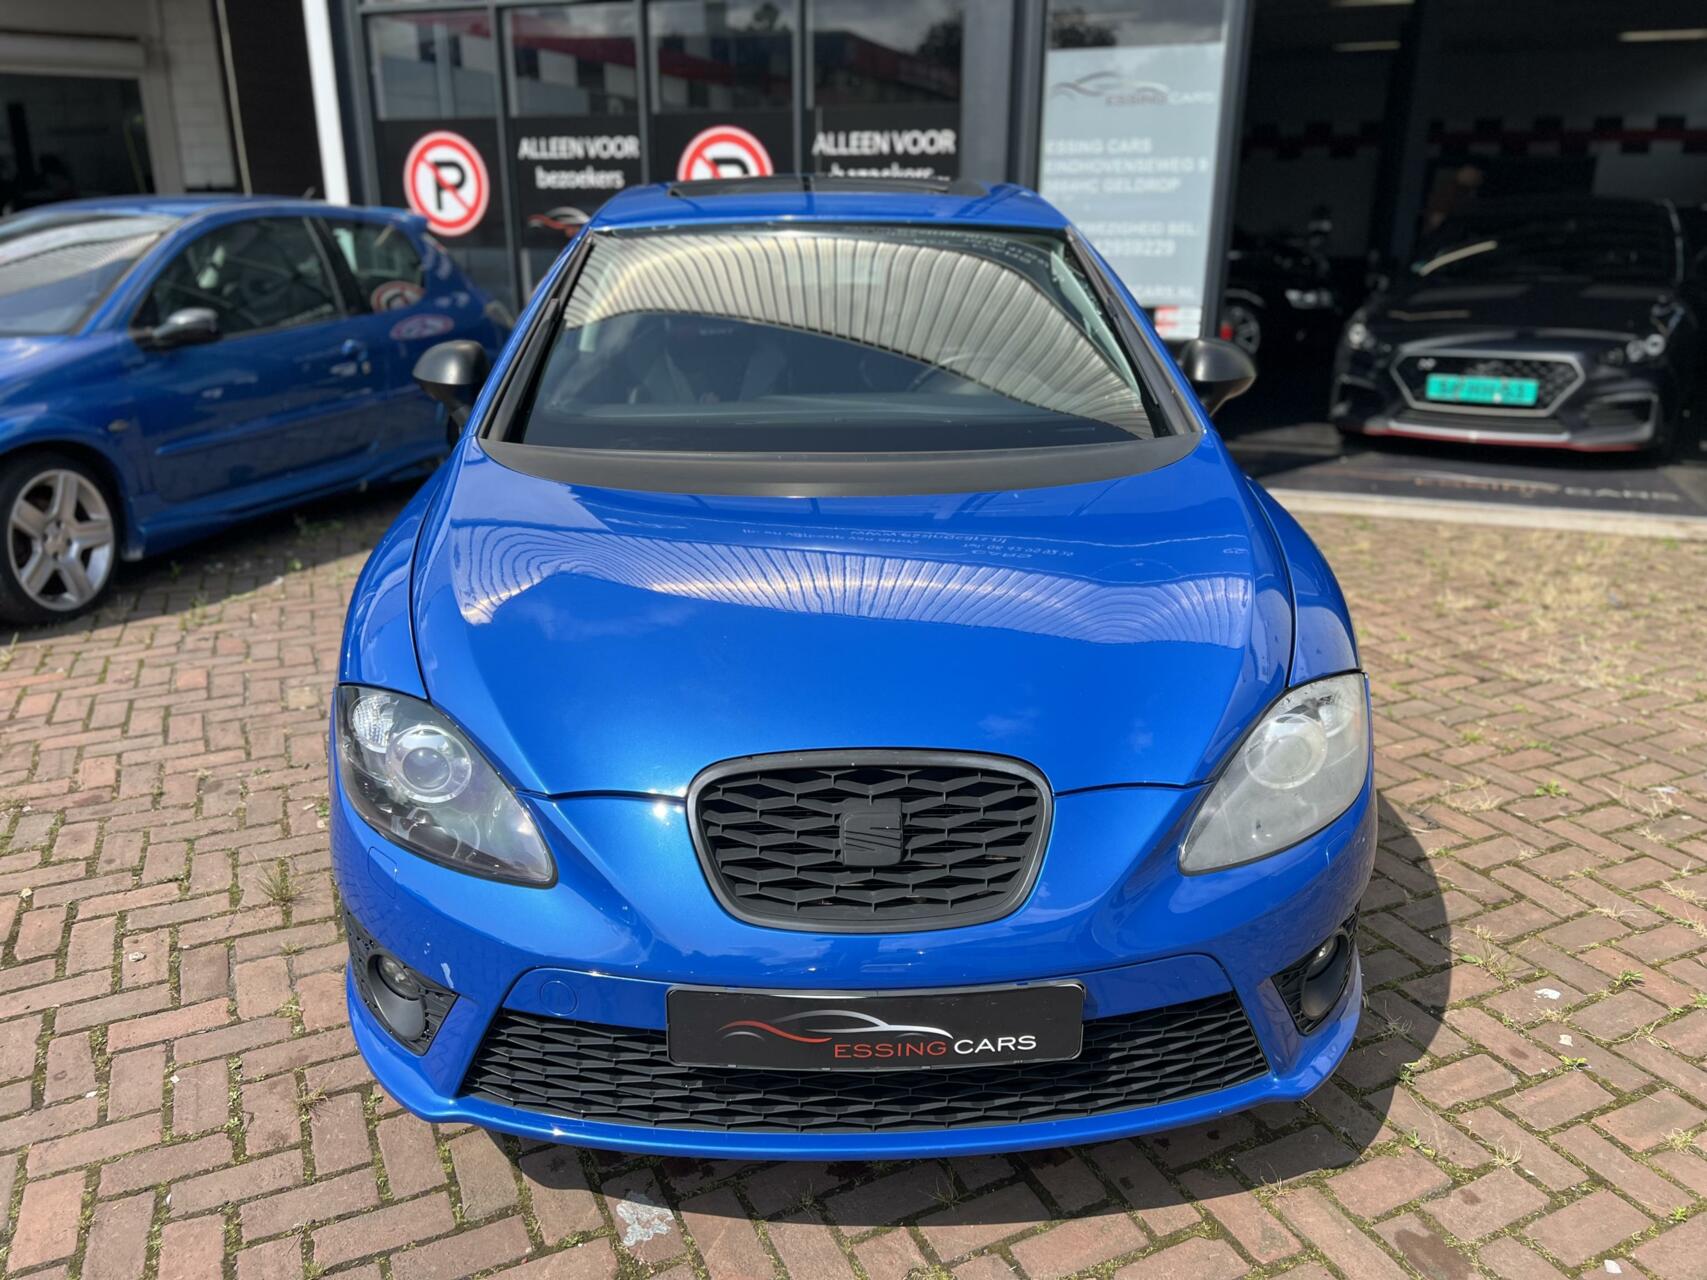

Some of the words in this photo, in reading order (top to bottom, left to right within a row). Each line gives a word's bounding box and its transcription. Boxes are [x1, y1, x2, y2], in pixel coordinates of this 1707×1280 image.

[518, 137, 584, 159] ALLEEN
[582, 135, 639, 158] VOOR
[812, 131, 882, 156] ALLEEN
[881, 129, 956, 154] VOOR
[535, 166, 625, 189] bezoekers
[834, 1041, 948, 1059] ESSING
[953, 1036, 1037, 1055] CARS
